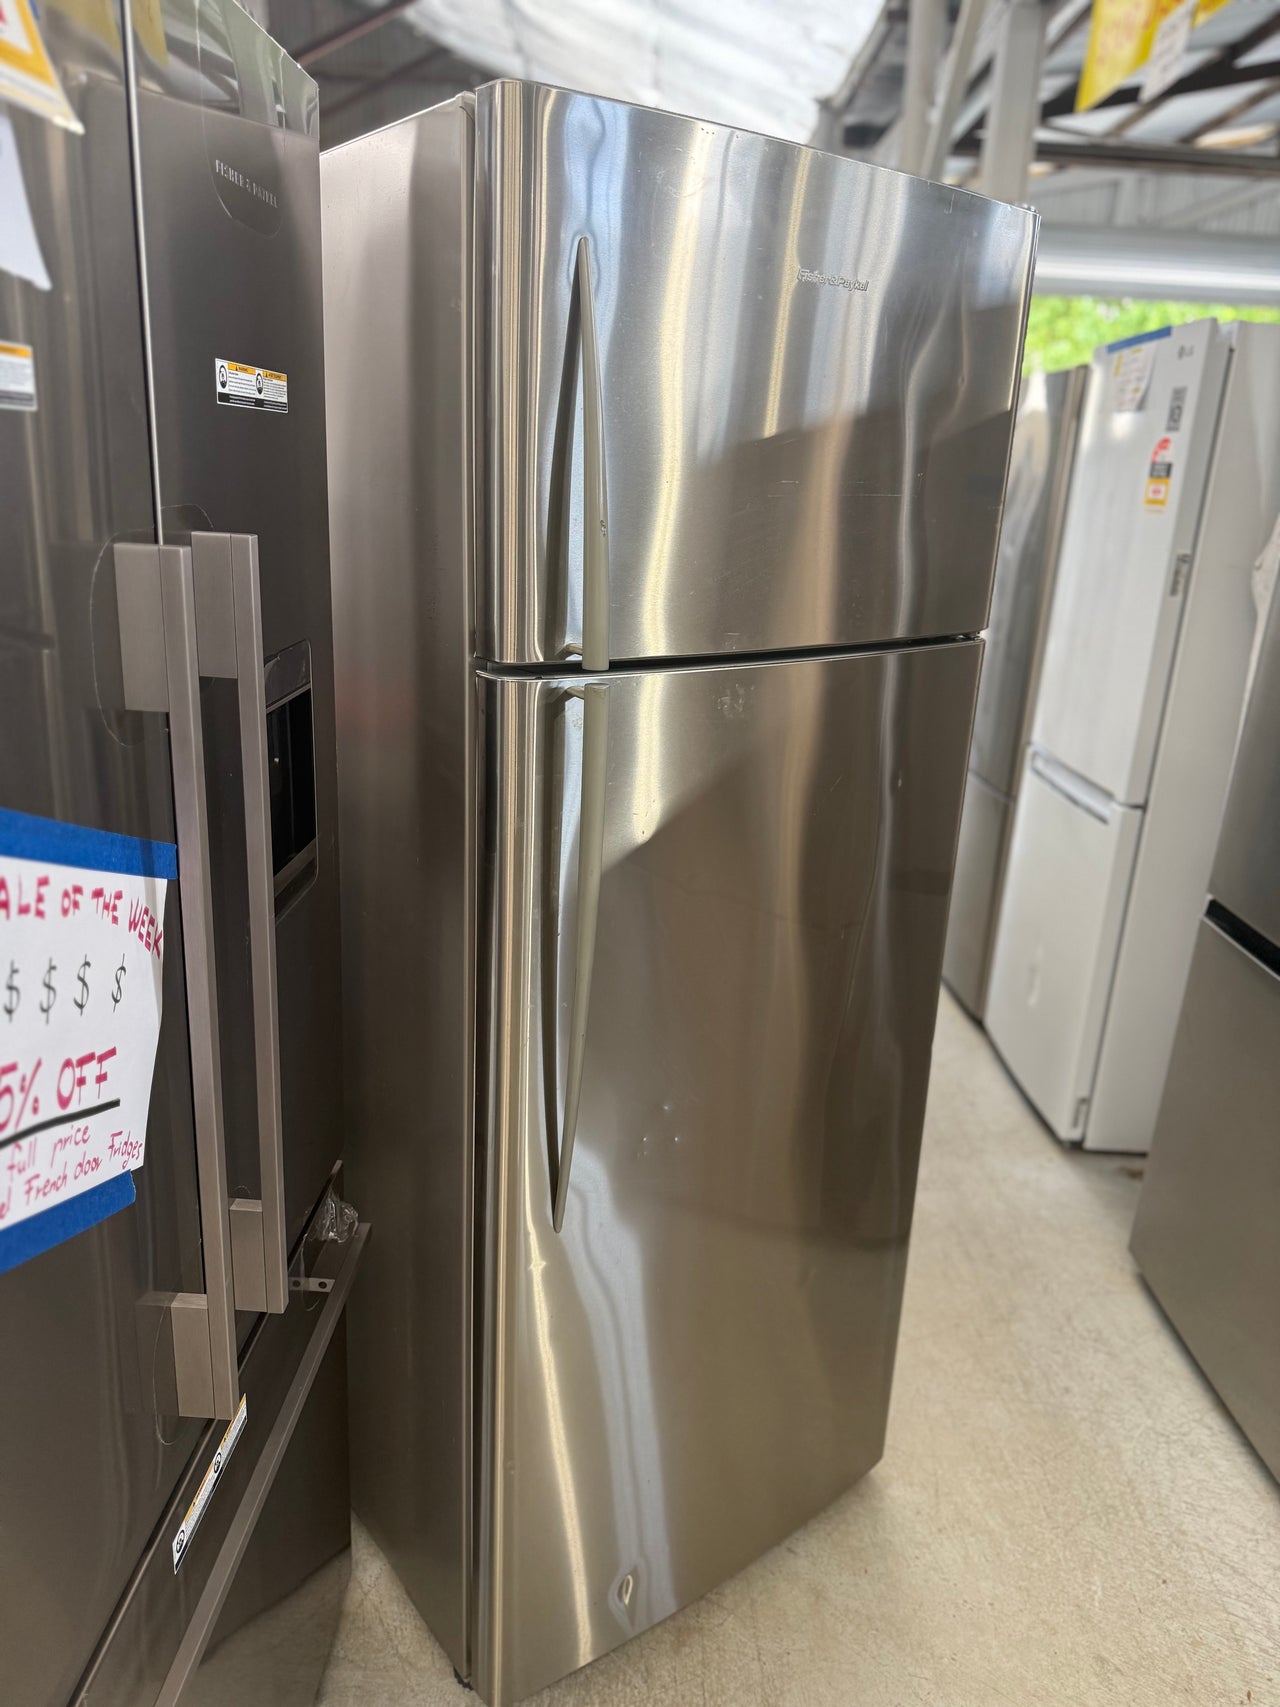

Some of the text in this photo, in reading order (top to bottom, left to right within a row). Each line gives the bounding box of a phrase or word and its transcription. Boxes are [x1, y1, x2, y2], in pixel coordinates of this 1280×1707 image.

[60, 884, 84, 919] OF
[91, 887, 124, 926] THE
[128, 896, 163, 960] WEEK
[56, 1046, 117, 1110] OFF
[24, 1173, 68, 1206] French
[74, 1150, 103, 1180] door
[107, 1130, 143, 1170] Fridges
[50, 1124, 91, 1169] price
